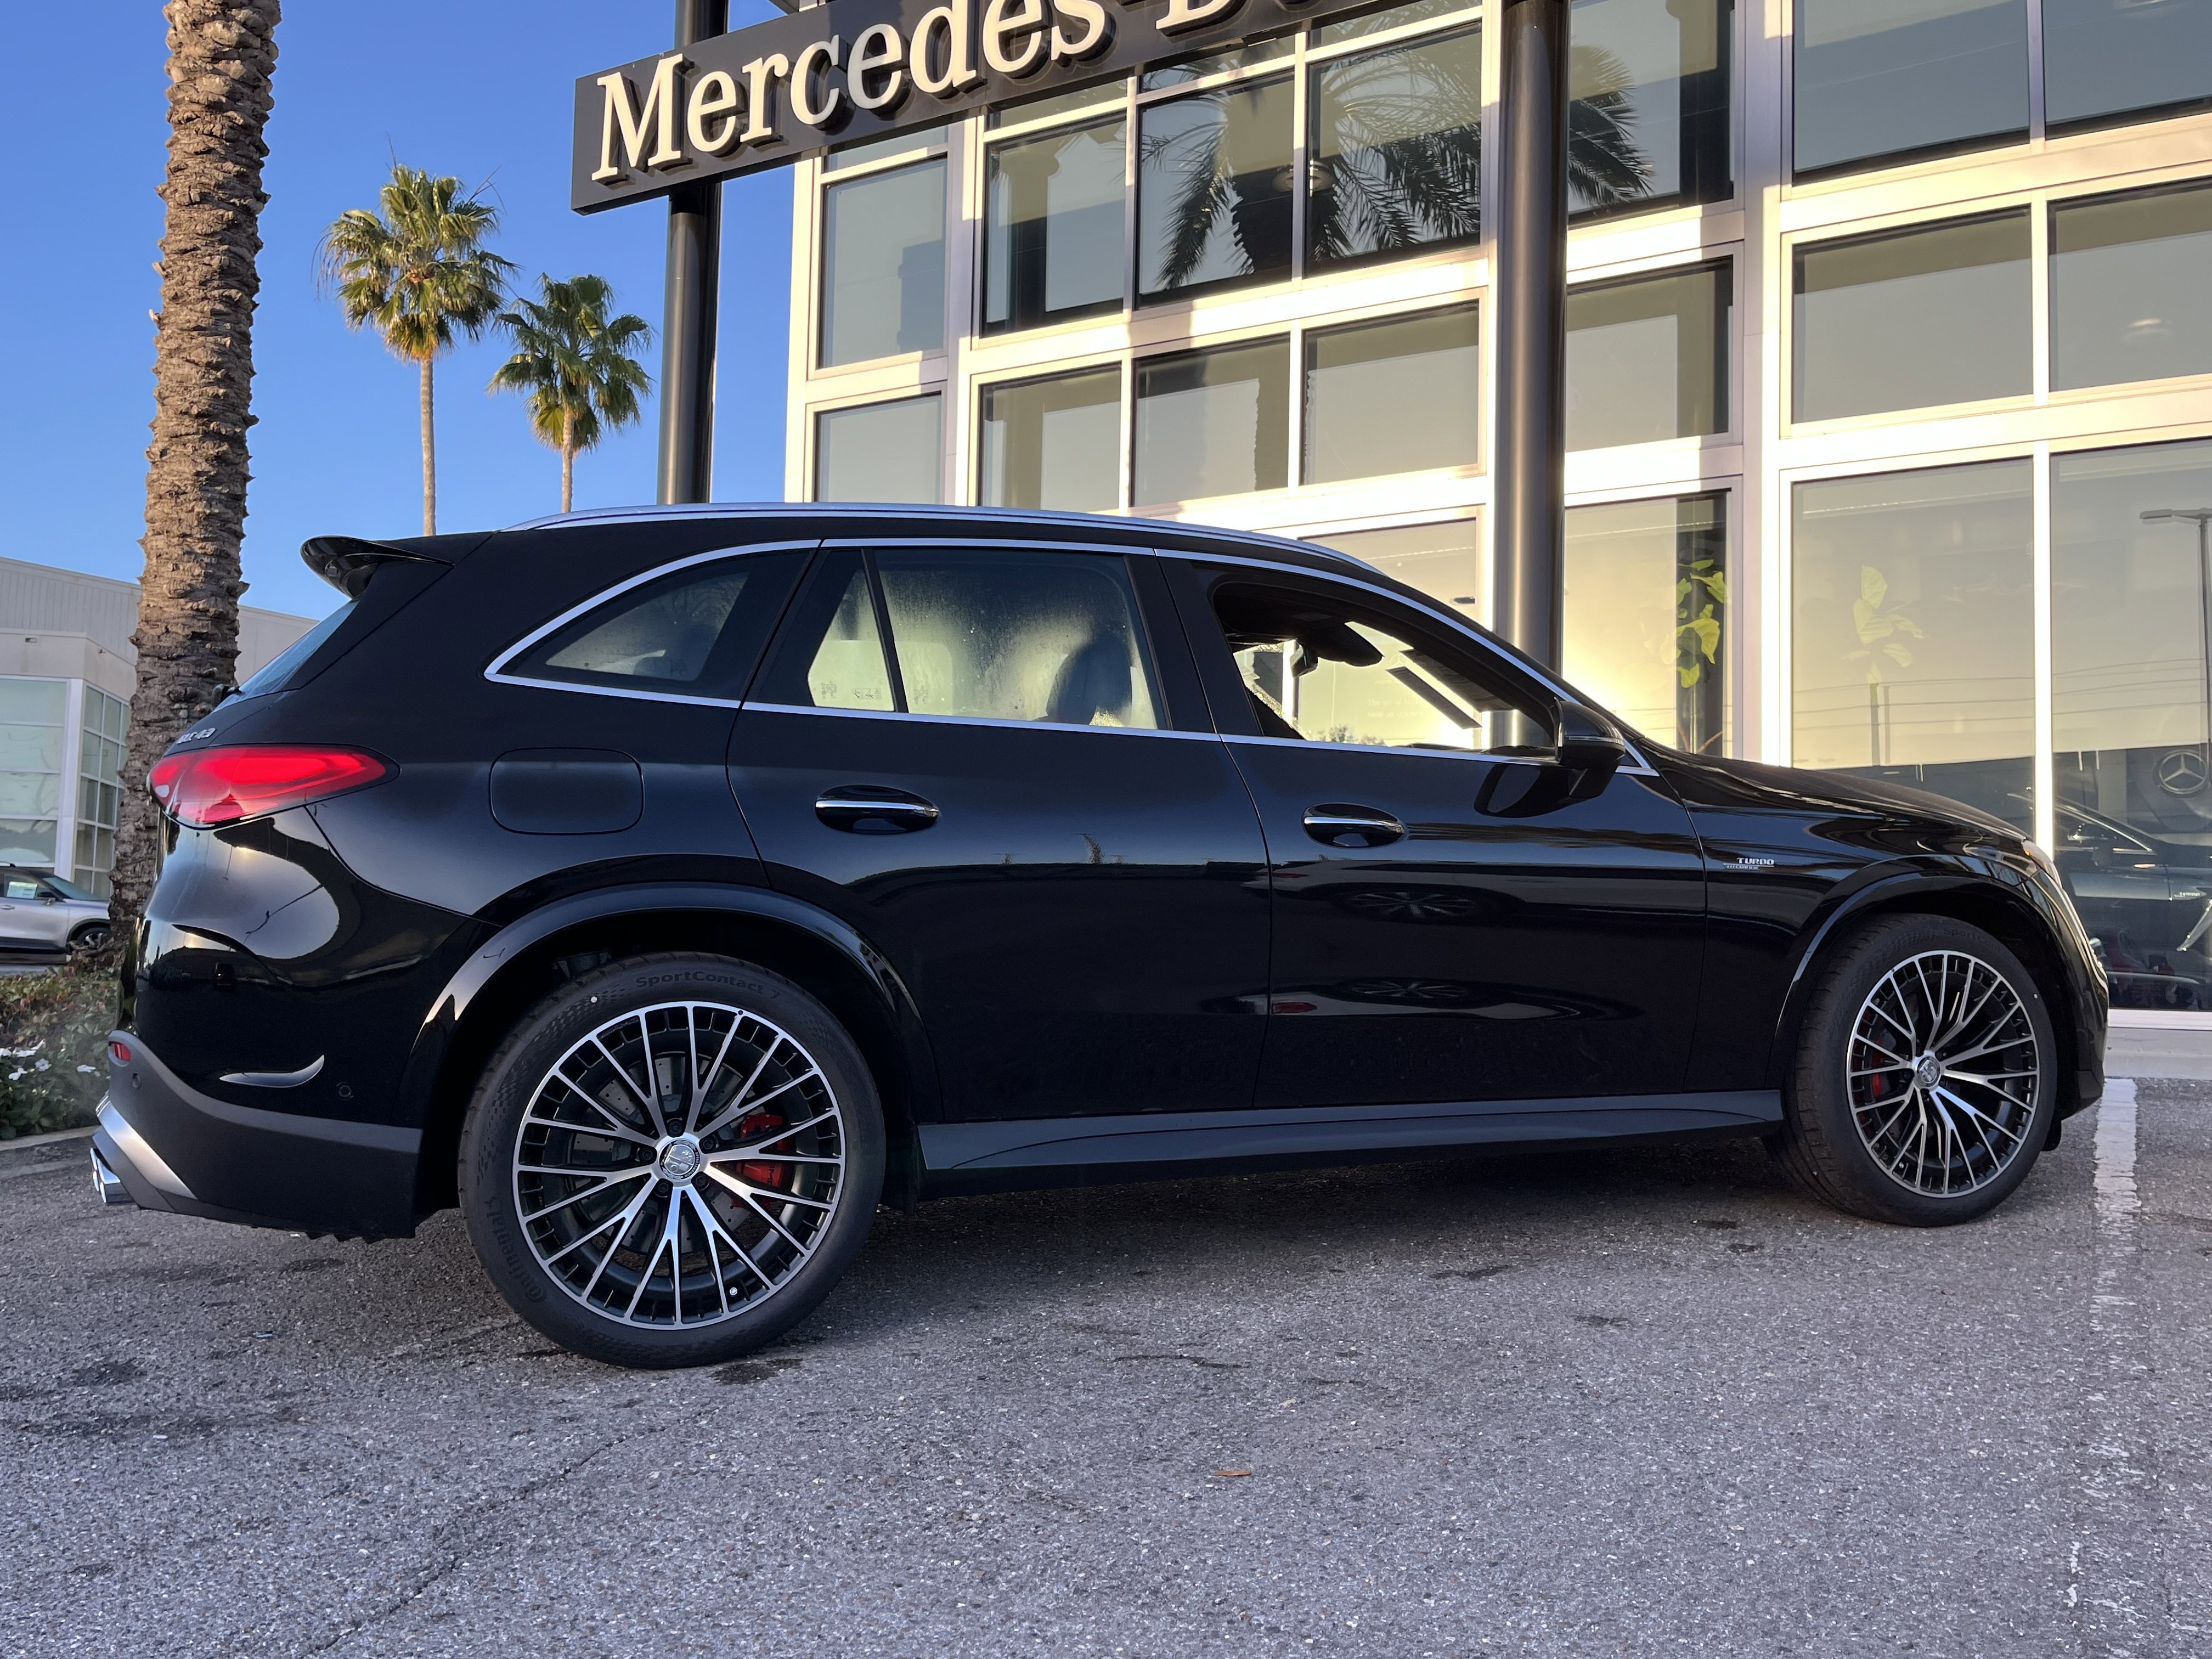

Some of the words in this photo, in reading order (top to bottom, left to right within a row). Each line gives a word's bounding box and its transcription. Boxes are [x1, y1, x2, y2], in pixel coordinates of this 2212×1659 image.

[194, 727, 216, 740] 43
[1736, 857, 1775, 865] TURBO
[635, 970, 764, 995] SportContact
[770, 991, 781, 1000] 7
[487, 1210, 545, 1304] Continental
